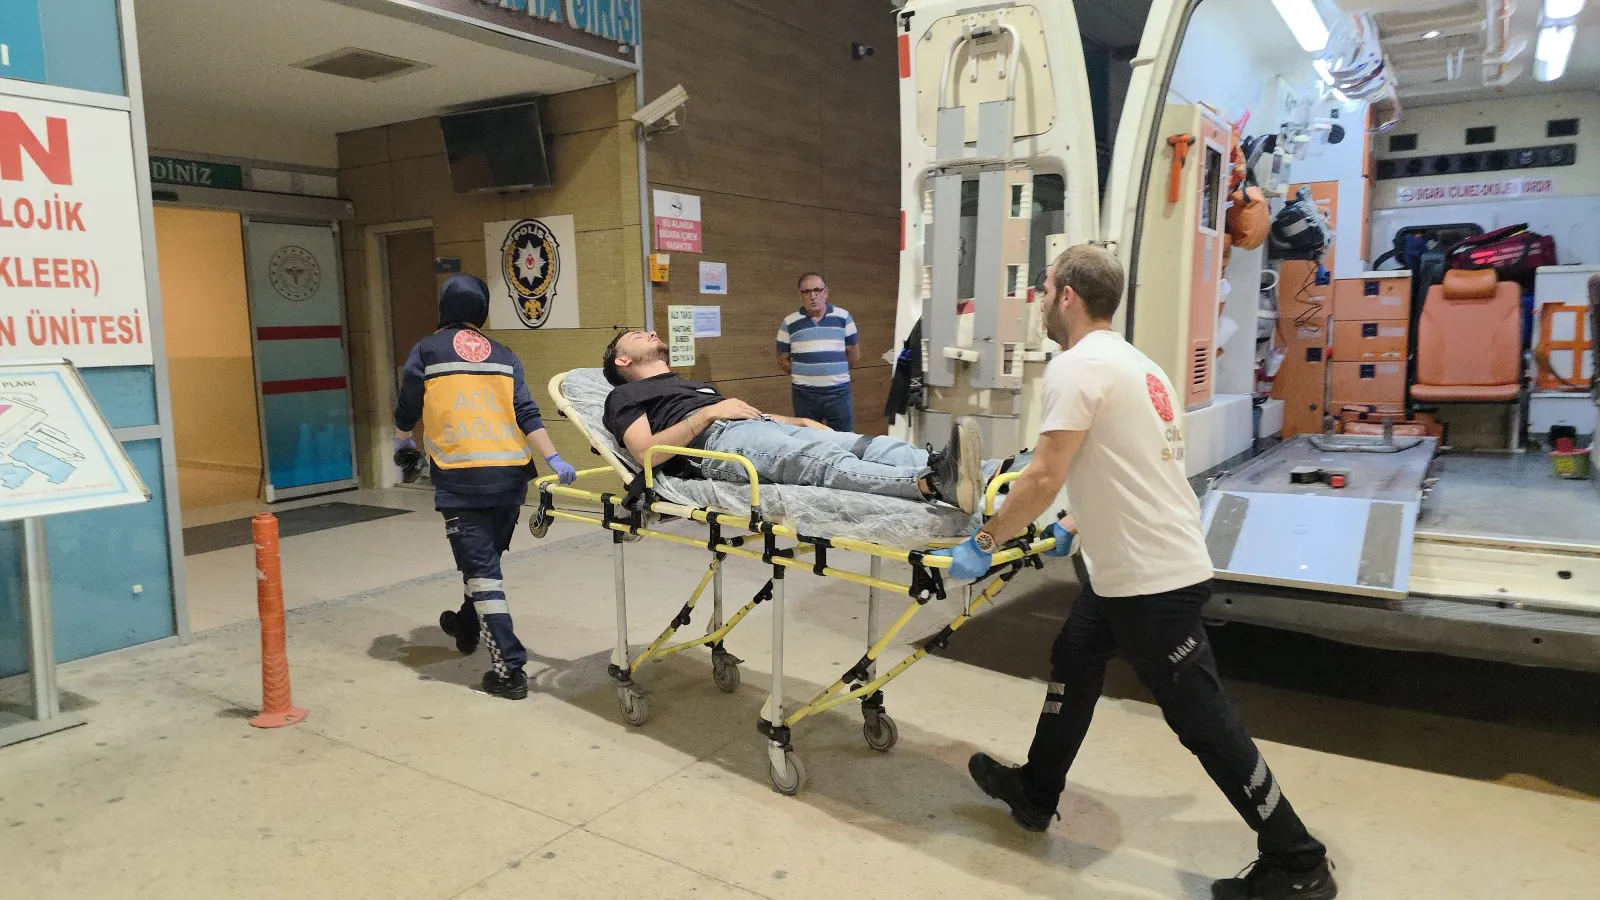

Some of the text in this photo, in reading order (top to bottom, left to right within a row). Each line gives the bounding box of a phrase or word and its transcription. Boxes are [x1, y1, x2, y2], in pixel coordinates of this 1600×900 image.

[150, 159, 213, 186] DİNİZ
[513, 225, 545, 240] POLİS
[27, 308, 144, 346] ÜNİTESİ
[2, 380, 36, 388] PLANI
[453, 387, 503, 412] ACİL
[443, 416, 520, 443] SAĞLIK
[1164, 425, 1182, 442] CİL
